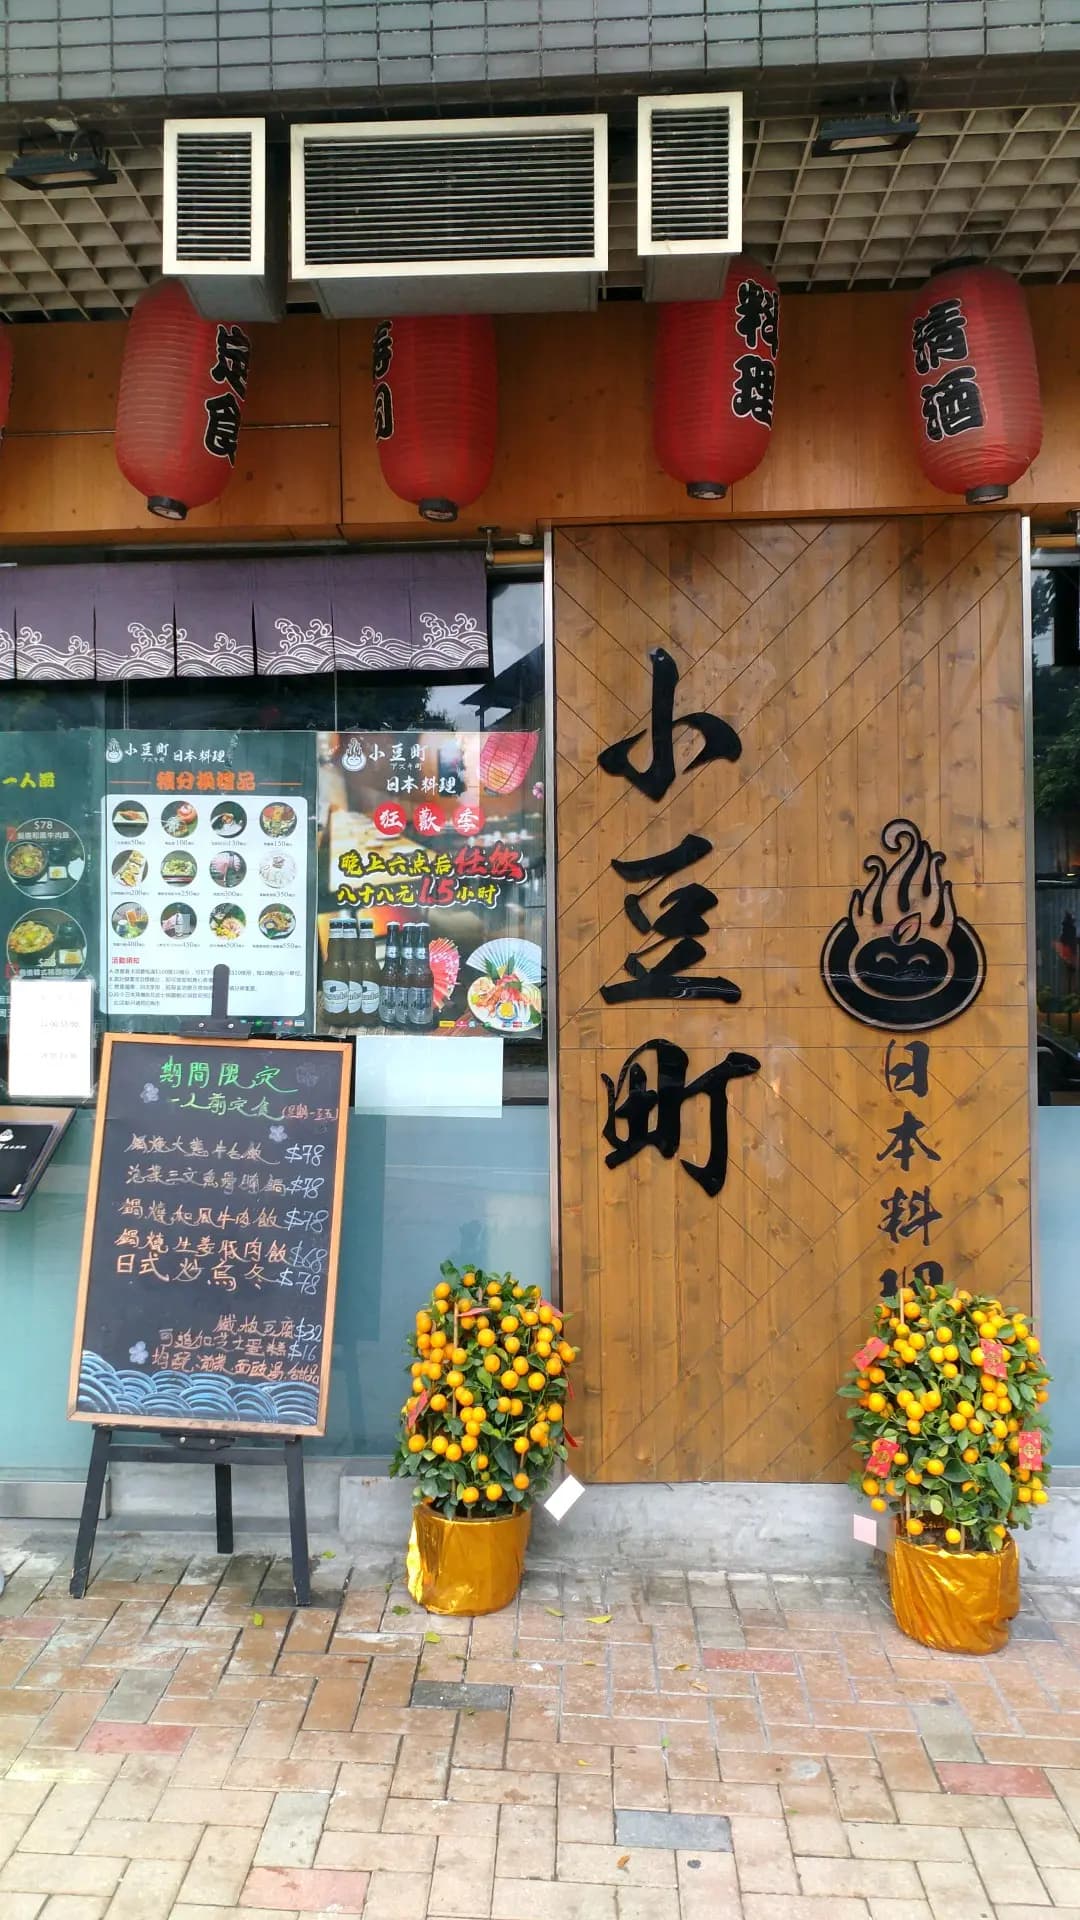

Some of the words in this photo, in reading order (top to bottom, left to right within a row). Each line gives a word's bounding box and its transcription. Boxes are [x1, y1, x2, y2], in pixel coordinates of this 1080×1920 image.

[912, 298, 986, 442] 清酒
[125, 742, 170, 756] 小豆町
[173, 749, 226, 764] 日本料理
[368, 743, 427, 762] 小豆町
[386, 776, 457, 795] 日本料理
[597, 647, 760, 1197] 小豆町
[159, 1055, 299, 1094] 期間限定
[284, 1143, 325, 1167] $78
[285, 1175, 325, 1199] $78
[282, 1207, 329, 1233] $78
[276, 1267, 321, 1295] $78
[293, 1317, 323, 1342] $32
[287, 1341, 318, 1361] $16
